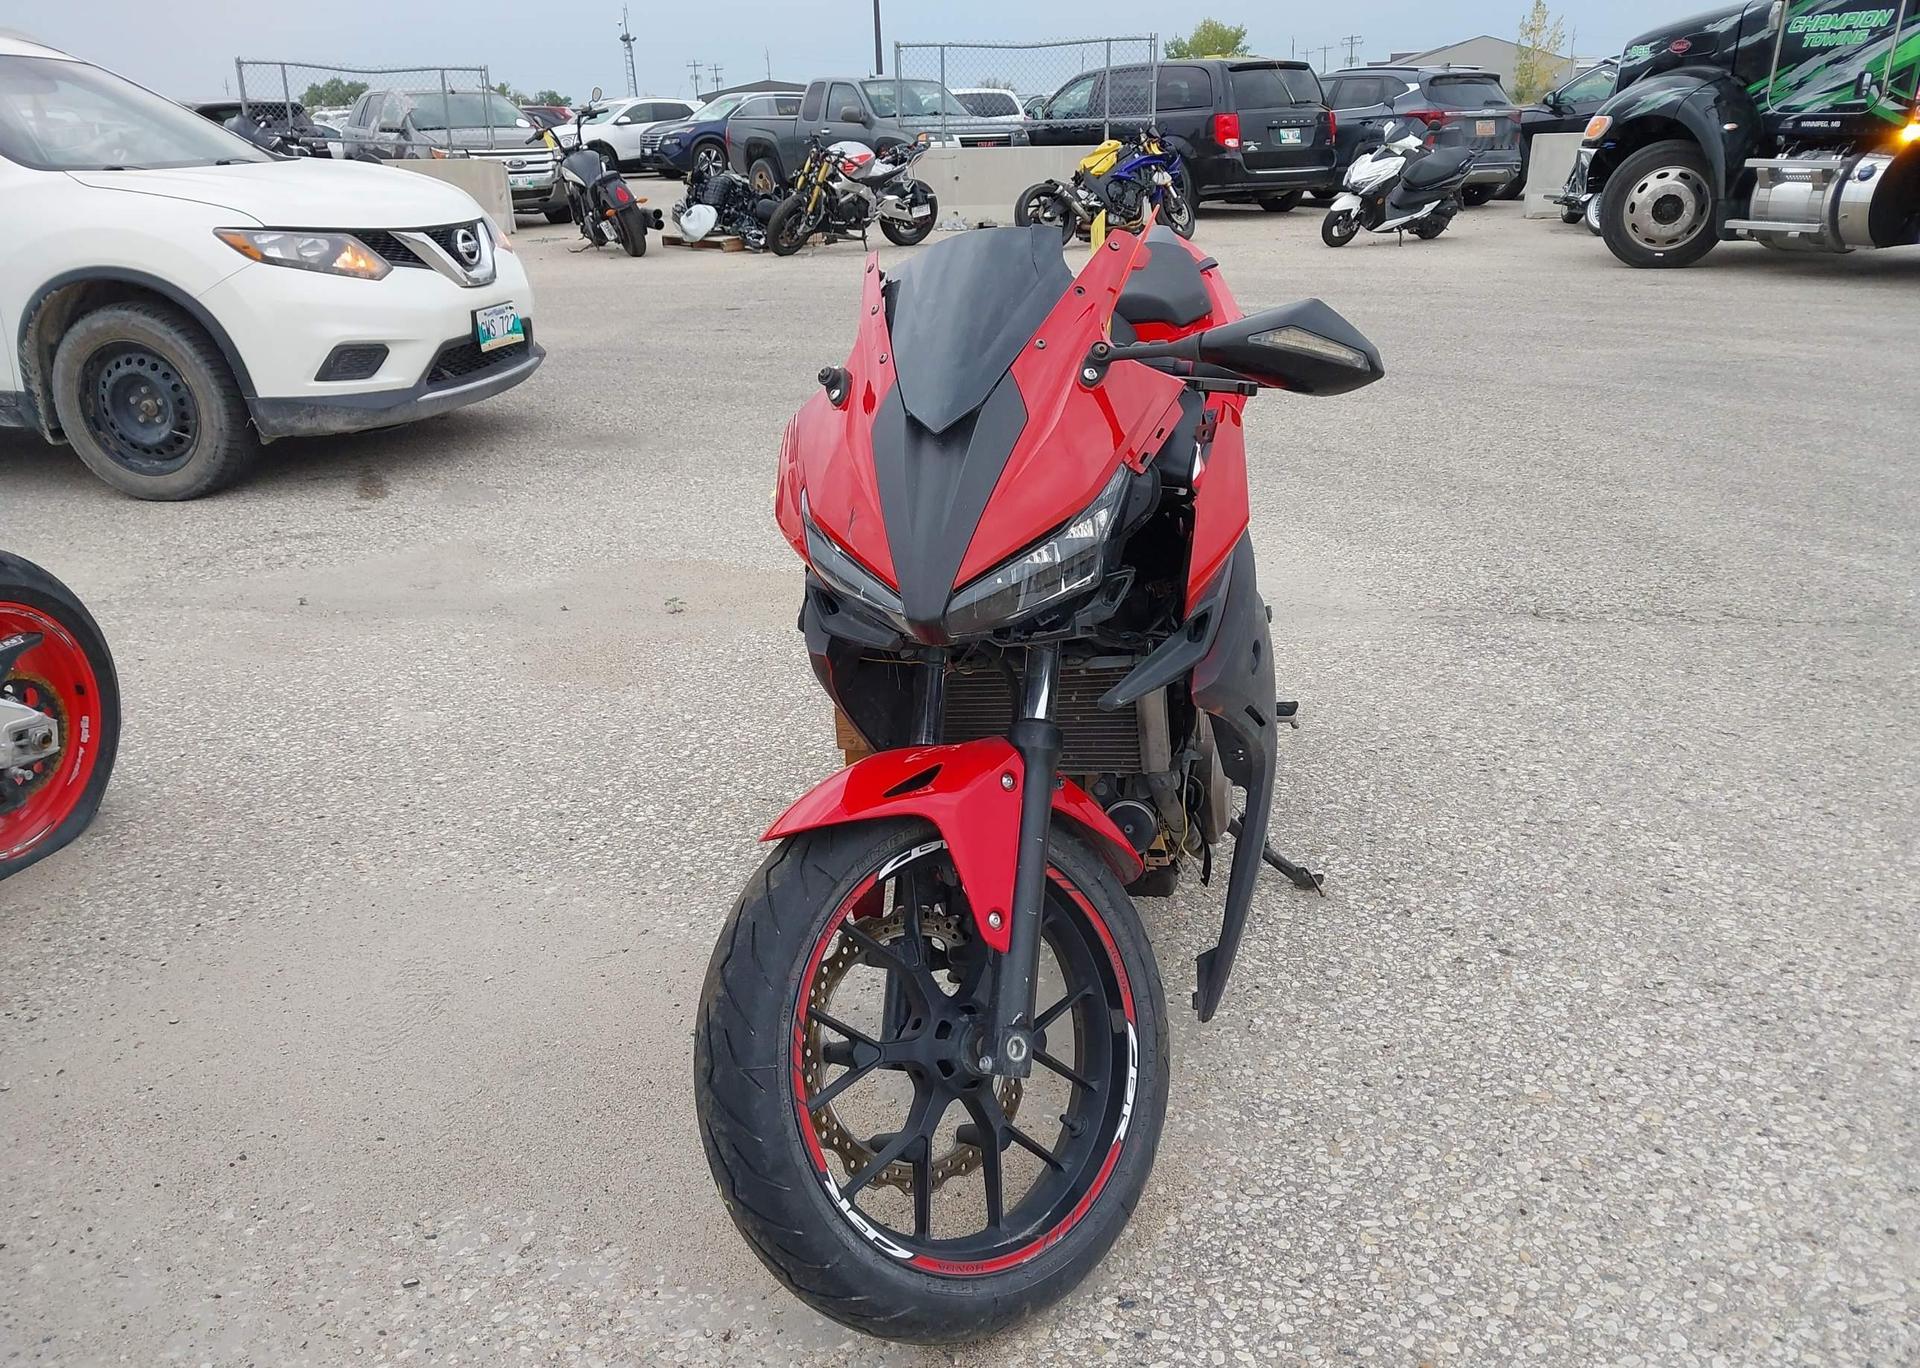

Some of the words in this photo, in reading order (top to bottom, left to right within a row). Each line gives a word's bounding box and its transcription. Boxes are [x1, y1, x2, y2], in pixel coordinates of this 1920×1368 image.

[1788, 9, 1895, 33] CHAMPION
[1802, 29, 1870, 48] TOWING
[879, 840, 948, 880] CB
[1113, 1021, 1138, 1144] CBR
[823, 1168, 915, 1259] CBR
